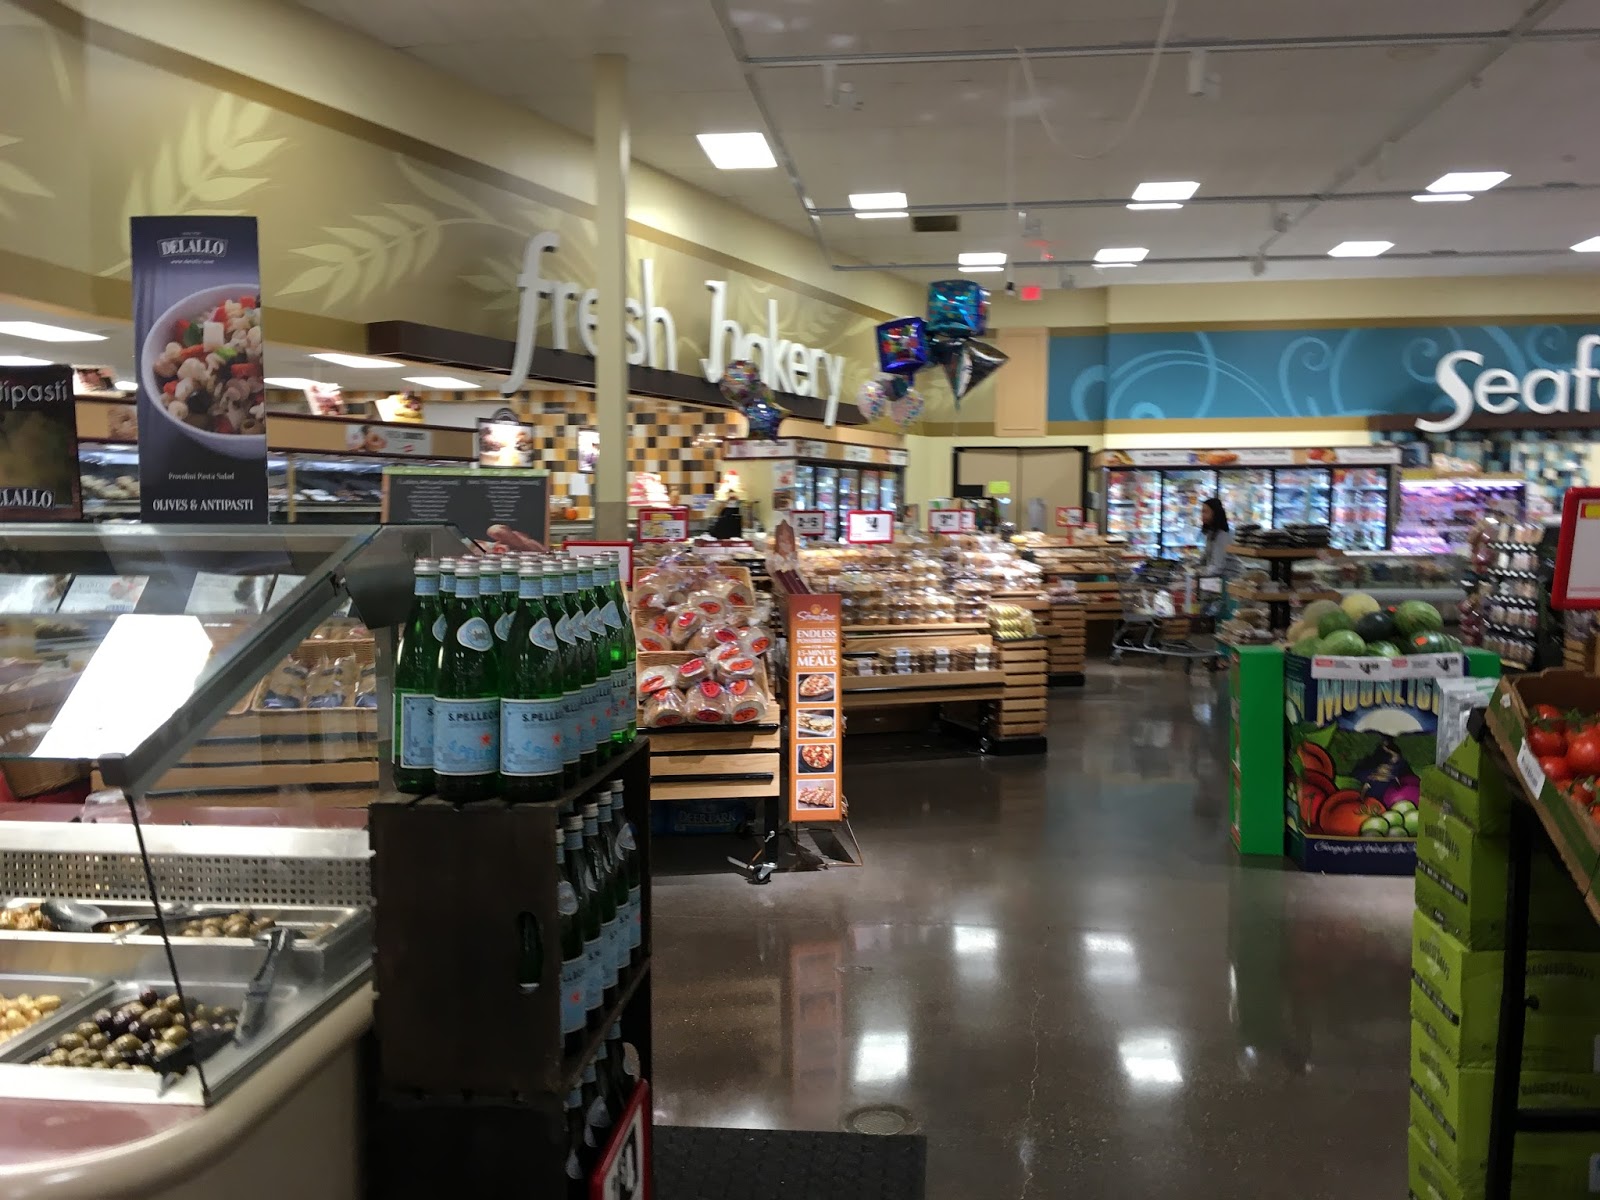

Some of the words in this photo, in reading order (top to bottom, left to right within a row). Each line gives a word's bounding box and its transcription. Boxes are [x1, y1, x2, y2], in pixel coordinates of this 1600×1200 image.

[161, 239, 224, 255] DELALLO
[499, 231, 678, 395] fresh
[1415, 334, 1600, 433] Seaf
[152, 499, 188, 511] OLIVES
[190, 499, 198, 511] &
[200, 499, 254, 511] ANTIPASTI
[796, 629, 837, 638] ENDLESS
[796, 656, 837, 667] MEALS
[520, 711, 562, 722] S.PELLE
